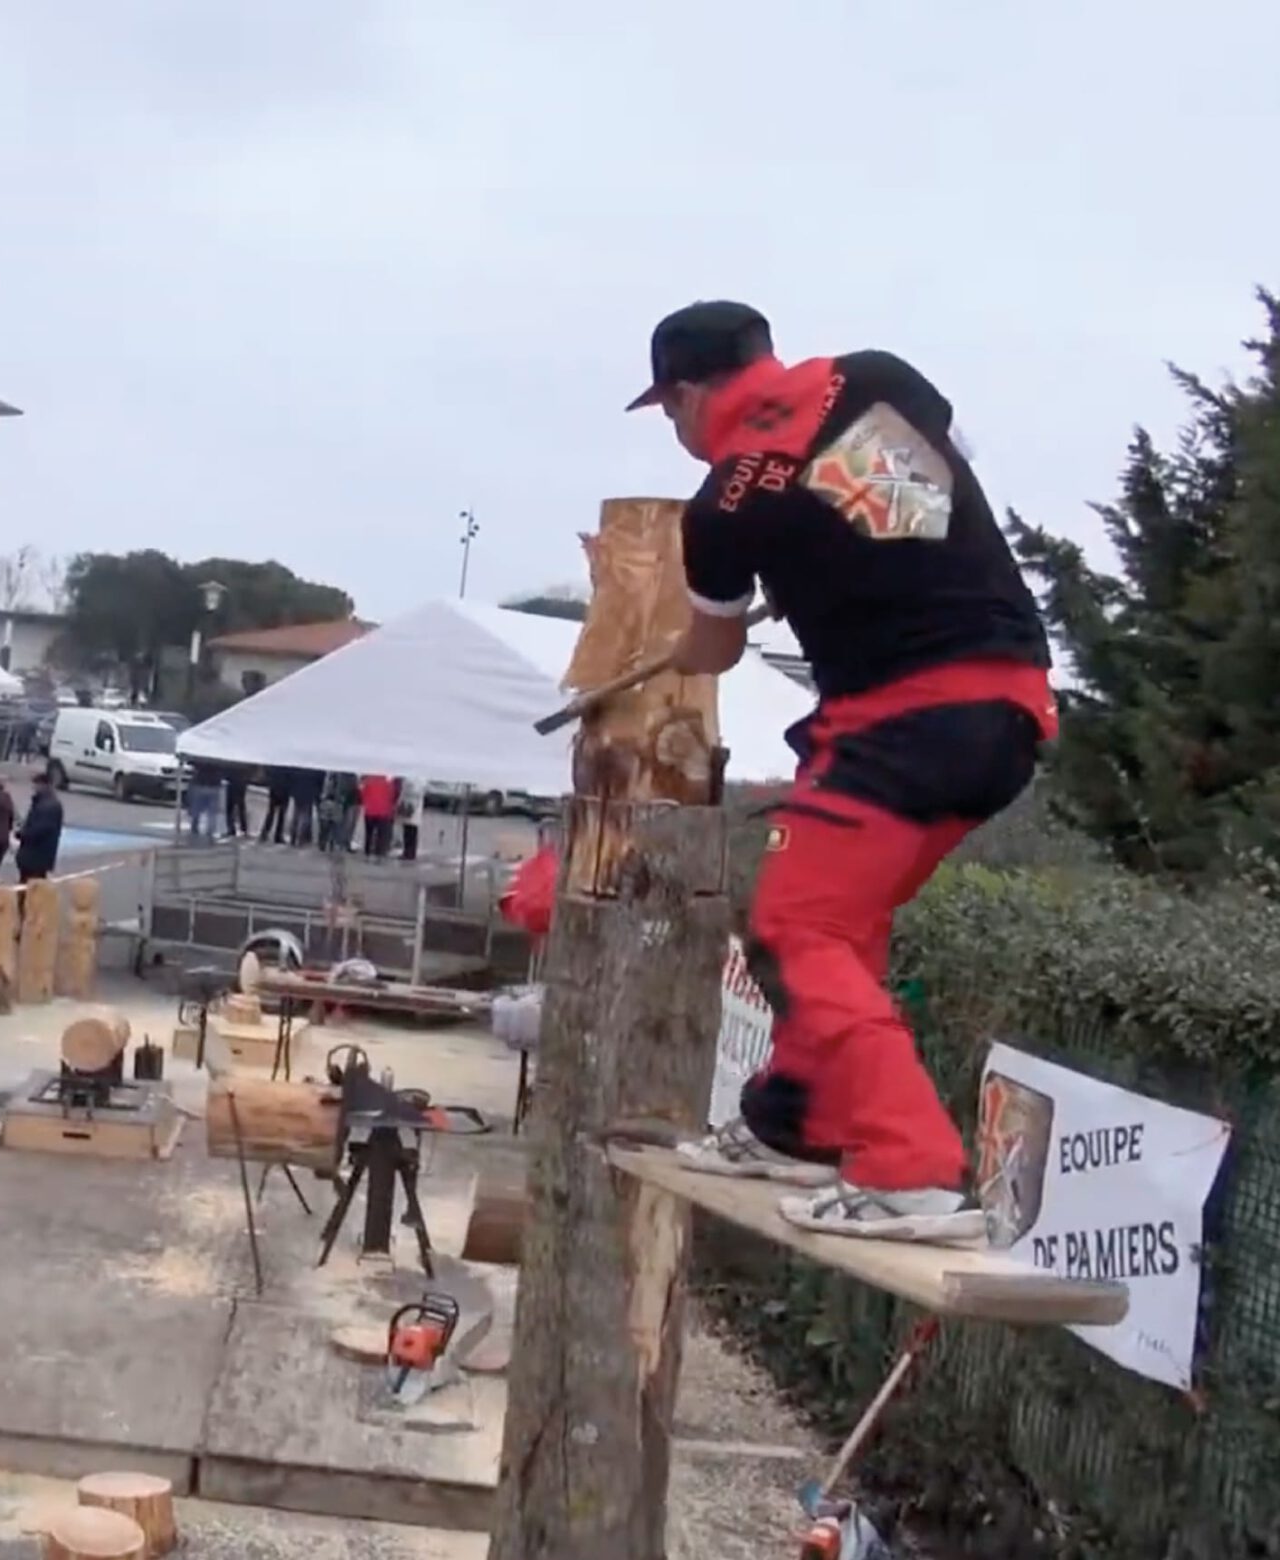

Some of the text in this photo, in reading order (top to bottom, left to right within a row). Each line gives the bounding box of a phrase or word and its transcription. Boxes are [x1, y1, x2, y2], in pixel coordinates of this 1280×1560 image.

[757, 459, 795, 493] DE
[1059, 1122, 1145, 1175] EQUIPE
[1065, 1220, 1180, 1279] PAMIERS
